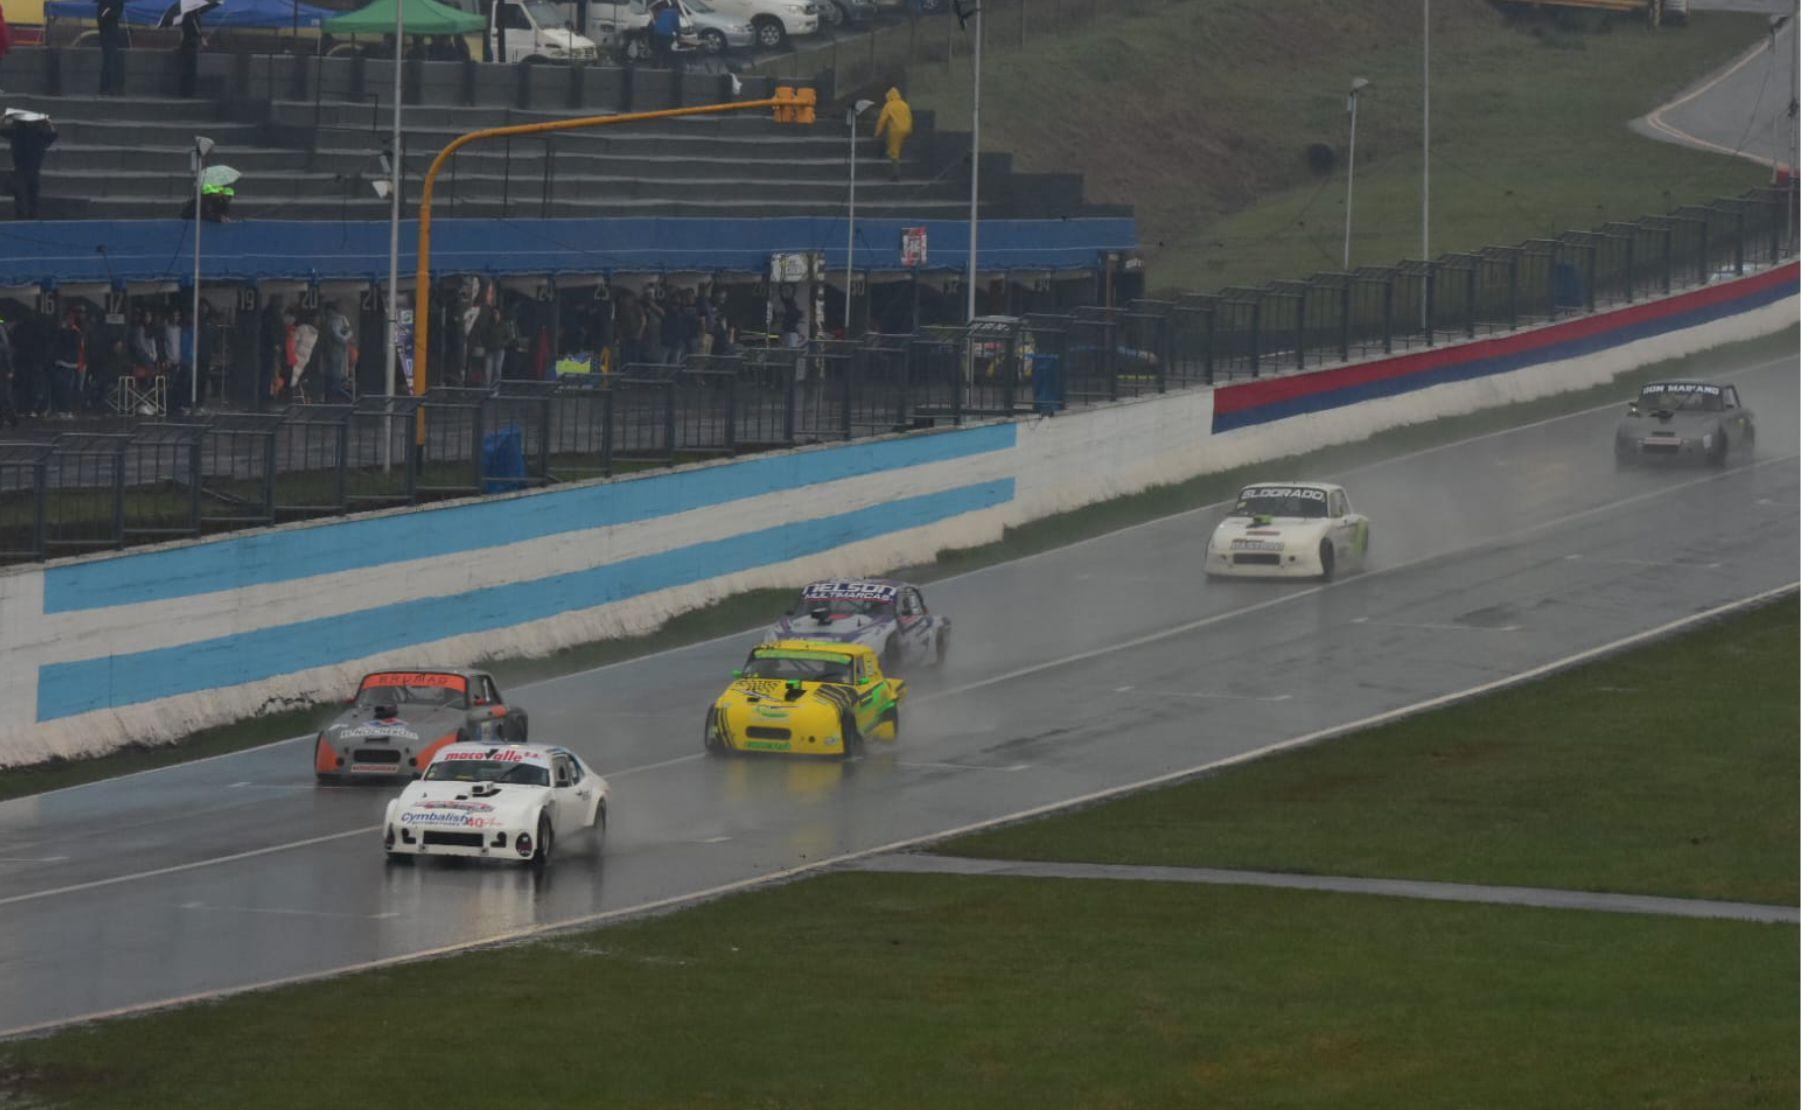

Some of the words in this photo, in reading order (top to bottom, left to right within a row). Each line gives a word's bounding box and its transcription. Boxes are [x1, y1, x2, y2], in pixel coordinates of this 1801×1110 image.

[40, 291, 54, 315] 16
[239, 289, 255, 311] 19
[302, 287, 318, 310] 20
[362, 287, 378, 311] 21
[1642, 384, 1665, 395] DON
[1241, 487, 1325, 501] ELDORADO
[802, 583, 897, 597] NELSON
[804, 592, 890, 601] MULTIMARCAS
